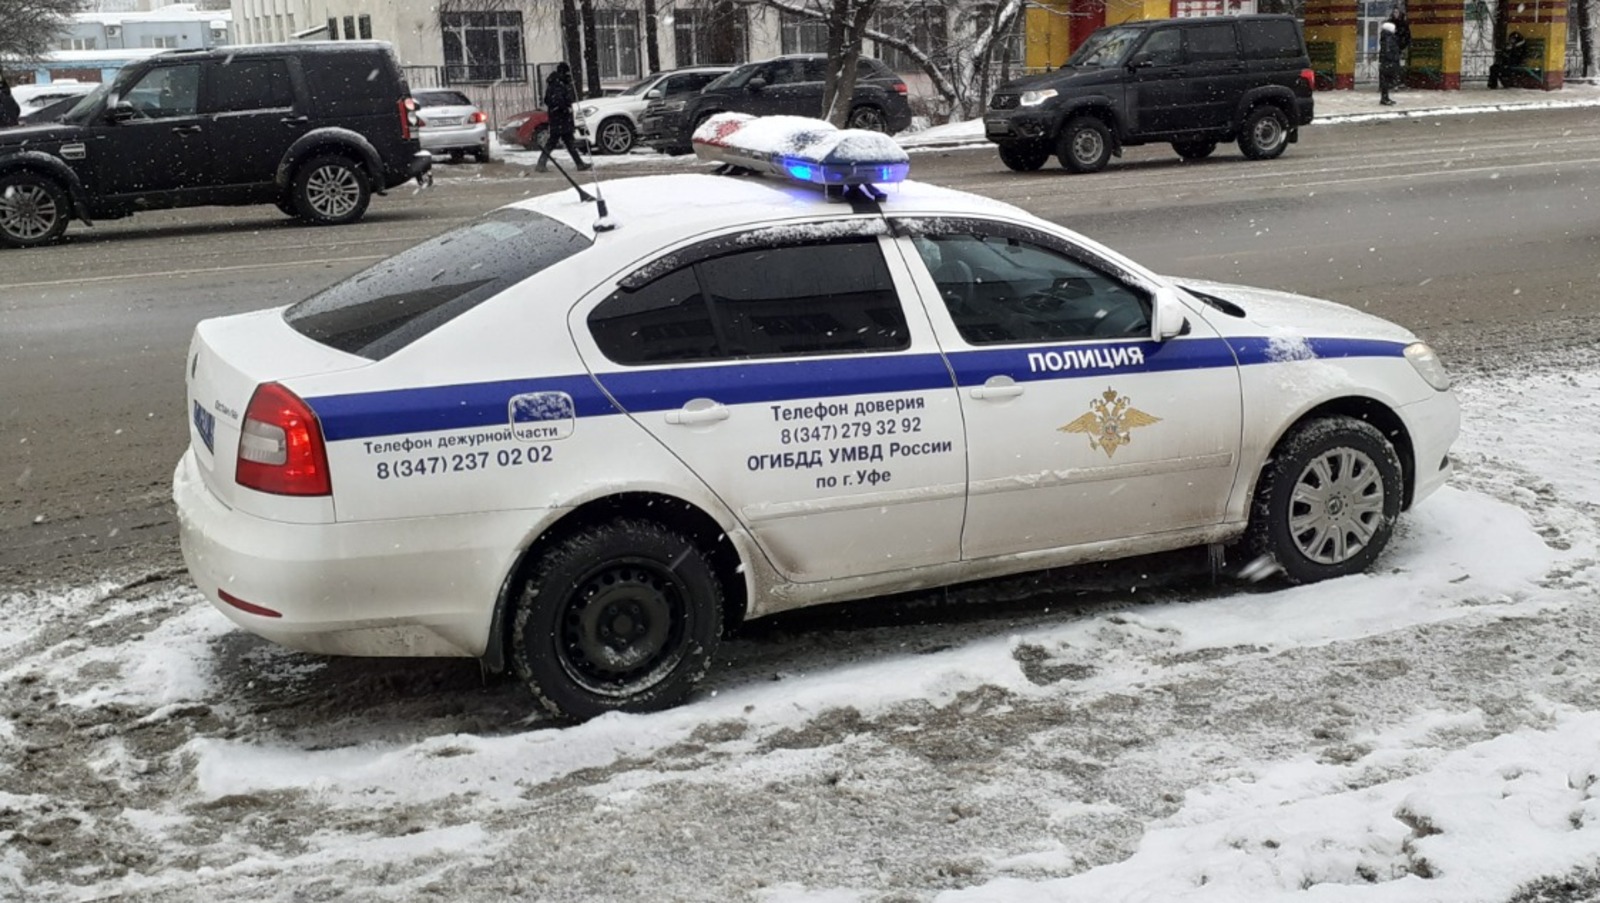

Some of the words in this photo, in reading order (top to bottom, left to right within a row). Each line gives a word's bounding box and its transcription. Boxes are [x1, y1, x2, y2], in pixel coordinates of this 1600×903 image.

[1028, 347, 1144, 372] ПОЛИЦИЯ
[771, 402, 849, 422] Телефон
[854, 396, 925, 415] доверия
[841, 421, 872, 439] 279
[876, 418, 896, 436] 32
[901, 416, 922, 434] 92
[364, 440, 433, 455] Телефон
[438, 429, 513, 448] дежурной
[516, 427, 559, 440] части
[451, 451, 490, 472] 237
[497, 447, 523, 467] 02
[527, 444, 554, 464] 02
[746, 451, 823, 472] ОГИБДД
[829, 443, 884, 464] УМВД
[889, 440, 953, 458] России
[816, 476, 838, 489] по
[842, 474, 853, 487] г.
[856, 468, 892, 487] Уфе
